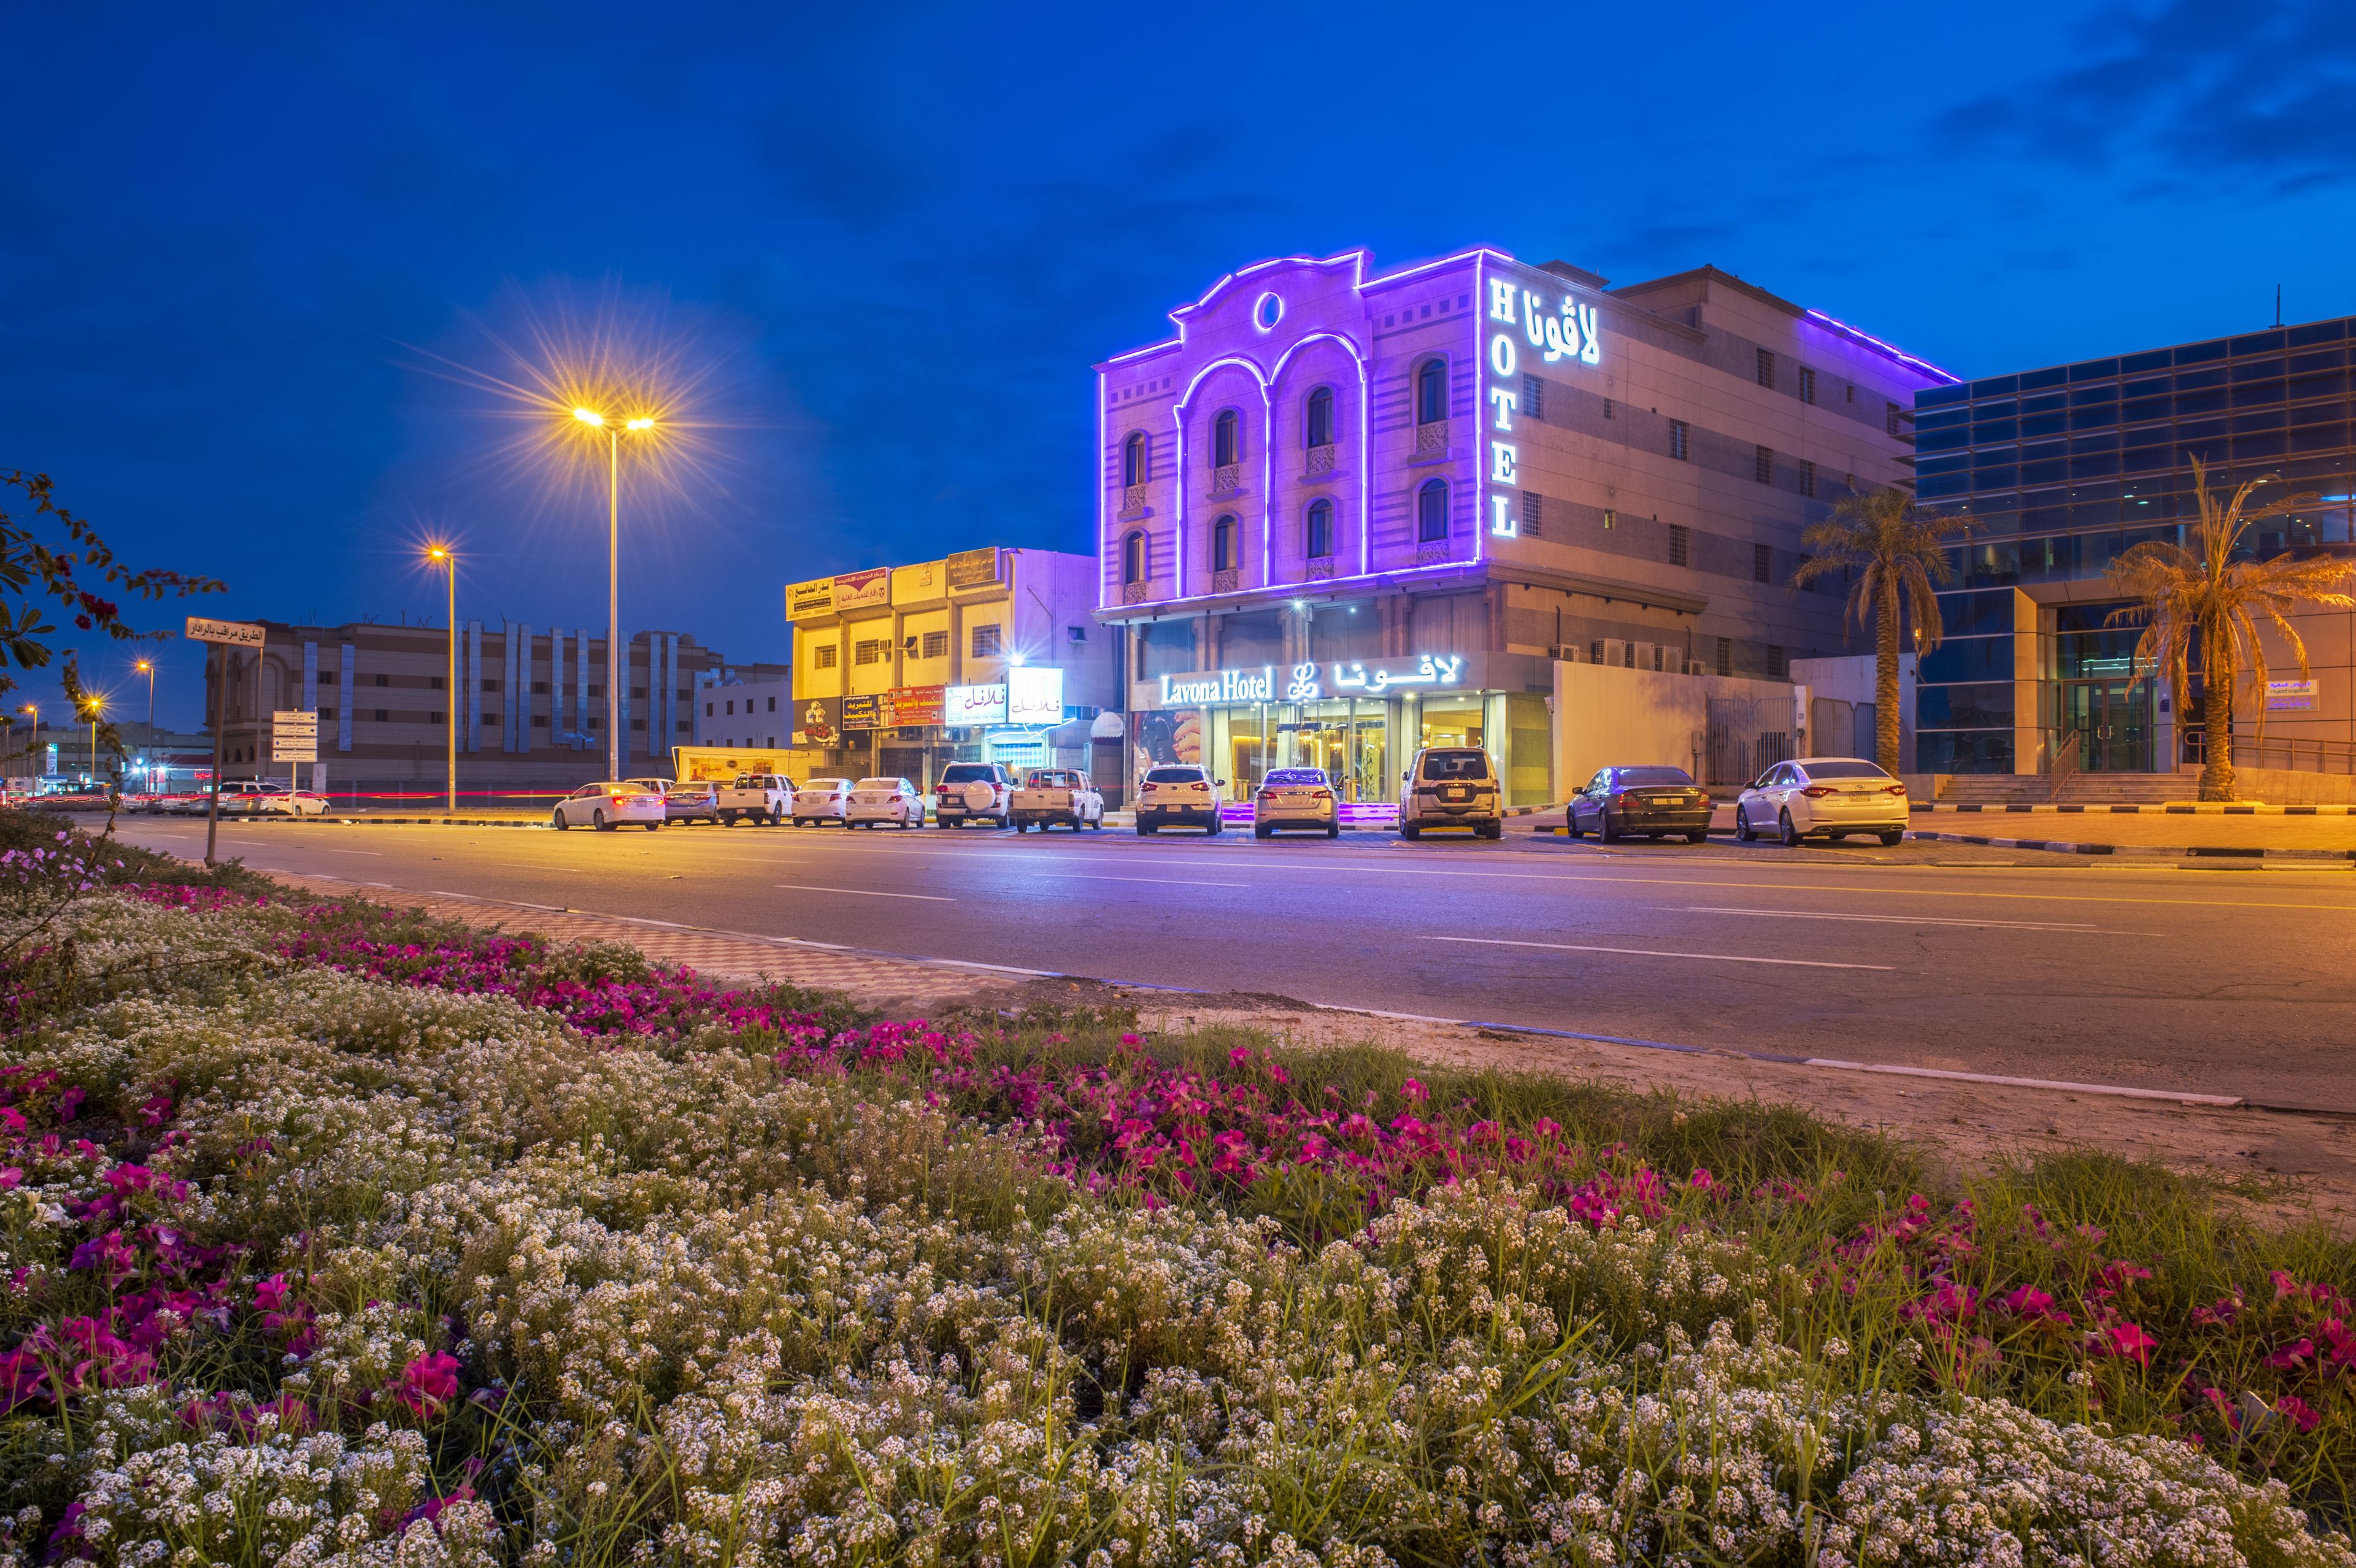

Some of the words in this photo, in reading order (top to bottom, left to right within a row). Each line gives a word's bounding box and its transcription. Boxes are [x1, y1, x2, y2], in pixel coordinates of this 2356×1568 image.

[1490, 278, 1516, 539] HOTEL
[818, 583, 829, 593] بدر
[190, 623, 215, 637] بالرادار
[216, 625, 237, 639] مراقب
[239, 628, 263, 642] الطريق
[1161, 675, 1221, 704] Lavona
[1222, 666, 1272, 701] Hotel
[847, 700, 872, 710] للتبريد
[895, 697, 919, 710] والتبريد
[964, 687, 1005, 710] فلافل
[1012, 698, 1060, 713] فلافل
[844, 710, 877, 721] والتكييف
